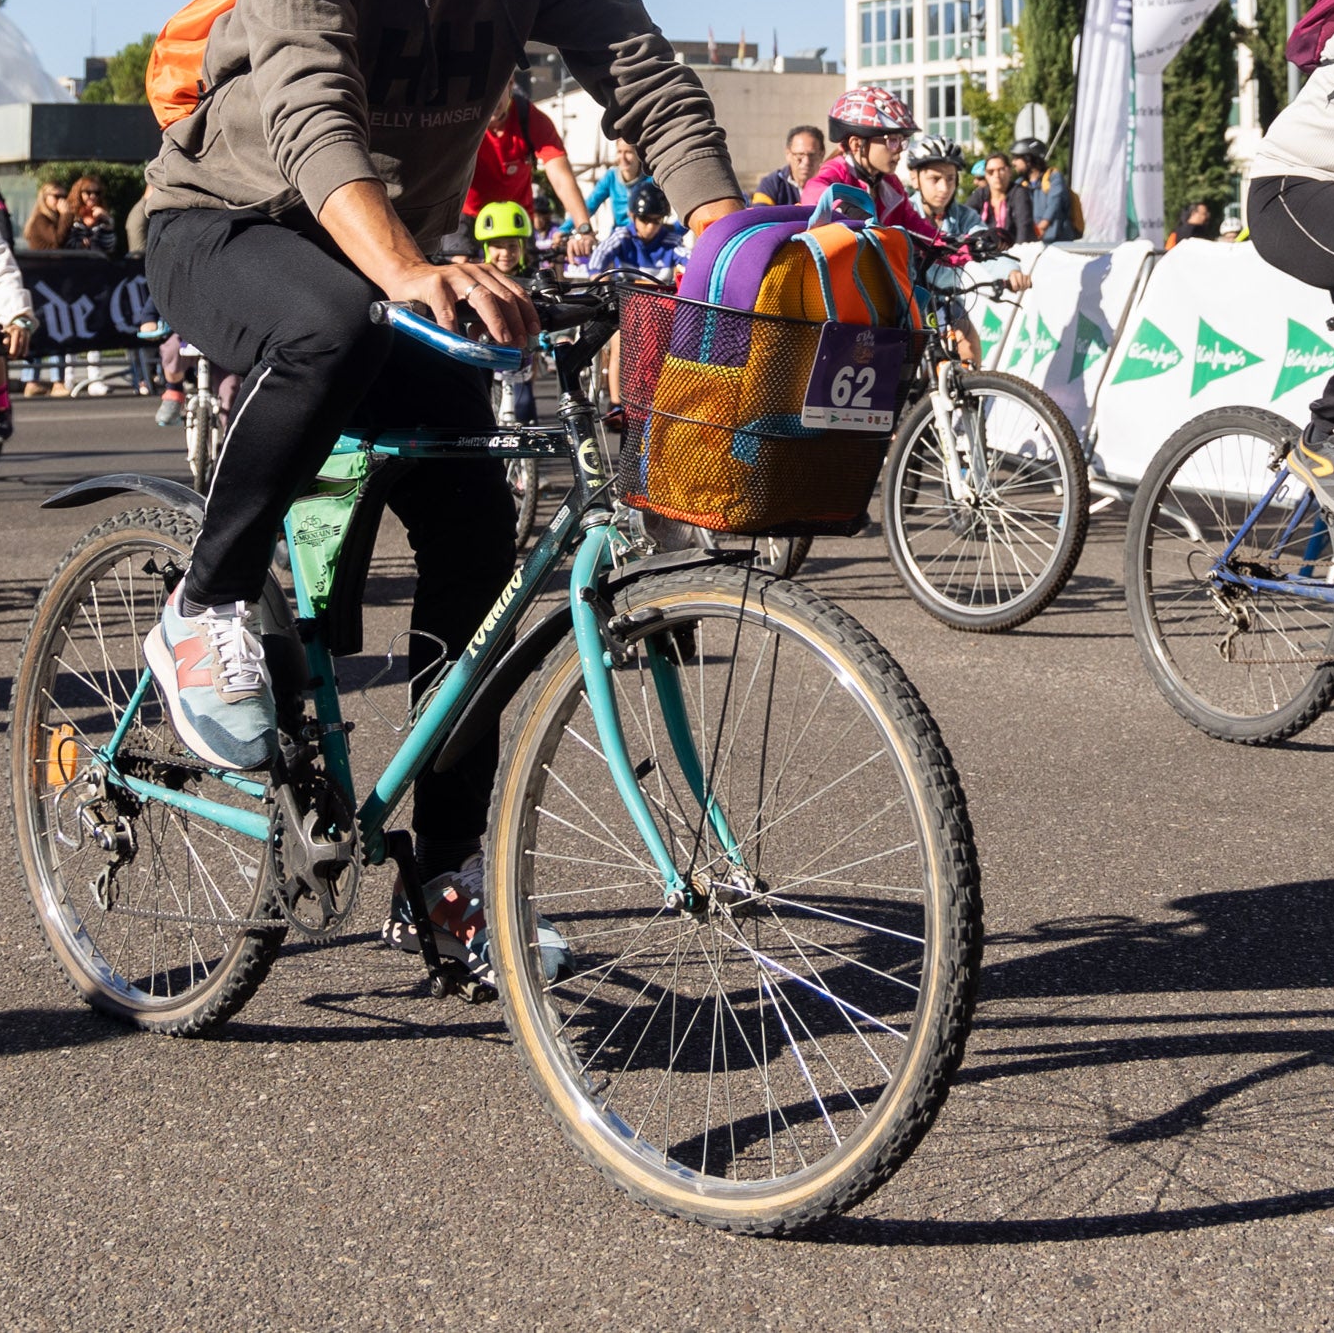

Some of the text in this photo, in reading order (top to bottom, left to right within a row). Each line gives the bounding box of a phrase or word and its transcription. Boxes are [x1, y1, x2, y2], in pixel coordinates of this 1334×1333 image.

[369, 106, 482, 128] ELLY HANSEN
[35, 280, 95, 343] de
[830, 365, 876, 408] 62
